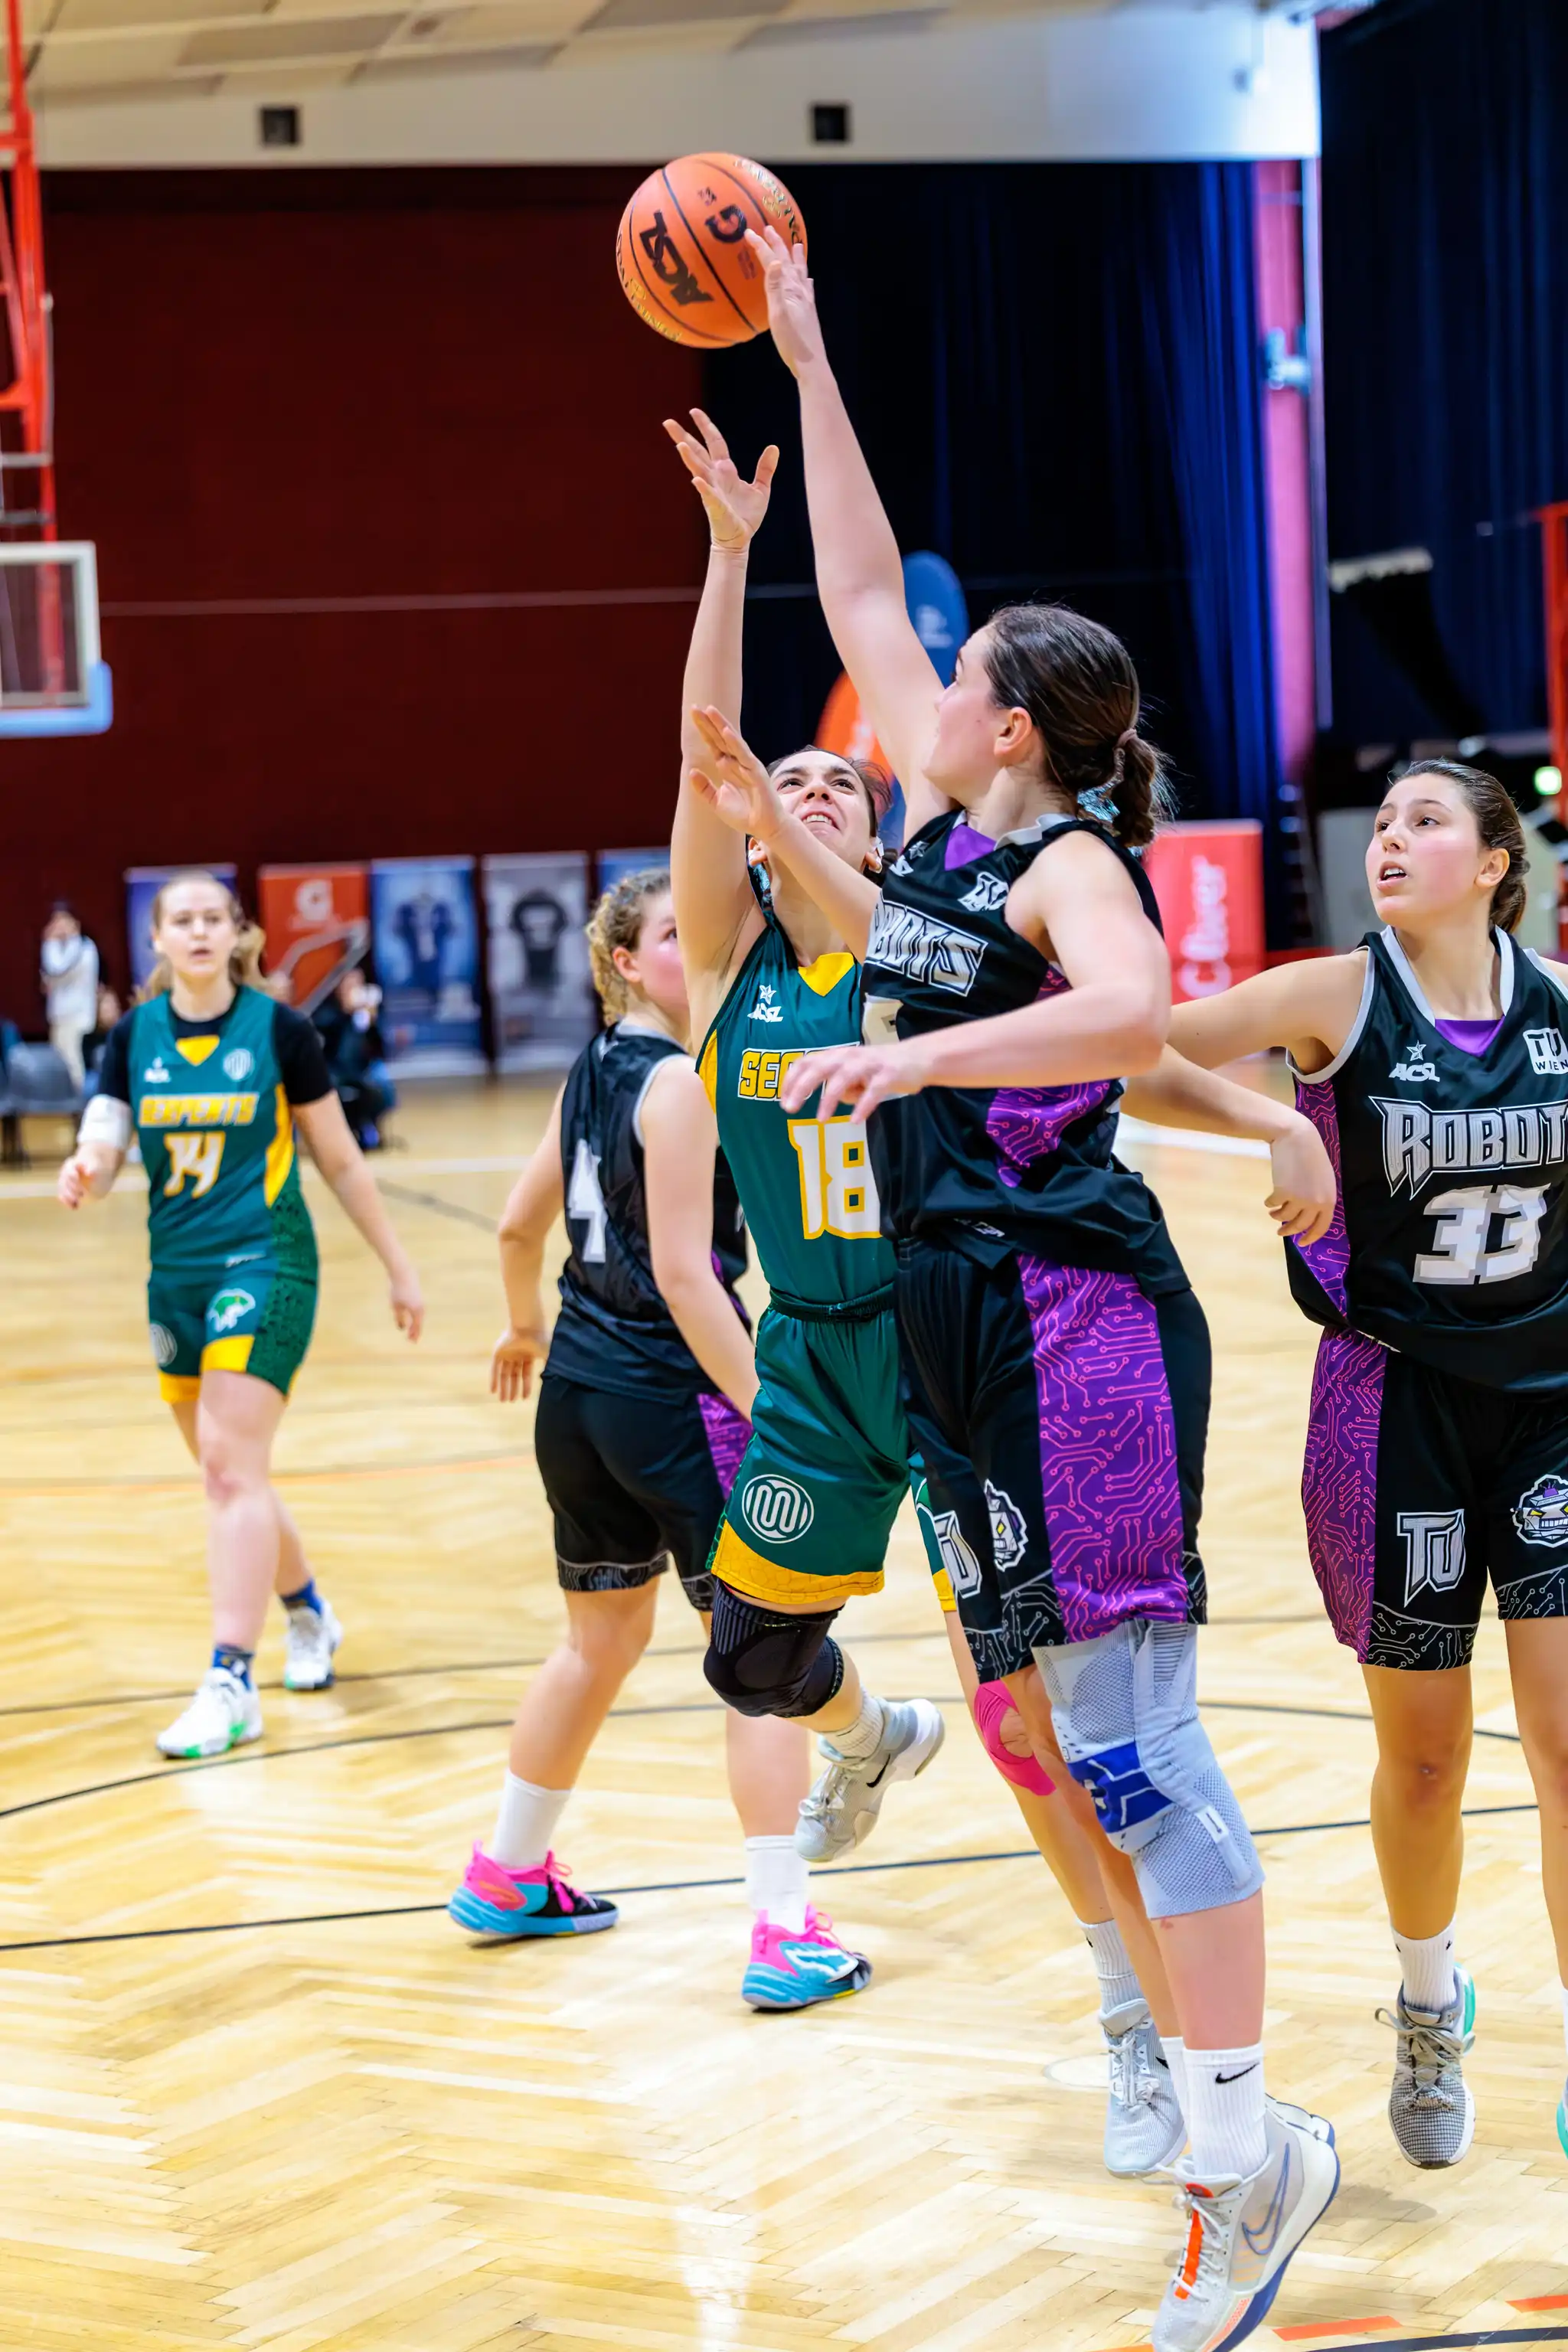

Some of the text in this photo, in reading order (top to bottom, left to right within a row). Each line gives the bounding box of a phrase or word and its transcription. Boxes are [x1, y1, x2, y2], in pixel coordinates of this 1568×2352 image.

[1388, 1062, 1440, 1083] ACSL
[1527, 1031, 1562, 1057] TU
[1535, 1059, 1568, 1071] WIEN
[163, 1132, 227, 1199] 14
[787, 1116, 882, 1240] 18
[1368, 1095, 1568, 1200] ROBOT
[568, 1138, 608, 1263] 4
[1412, 1182, 1552, 1285] 33
[1396, 1508, 1465, 1608] TU
